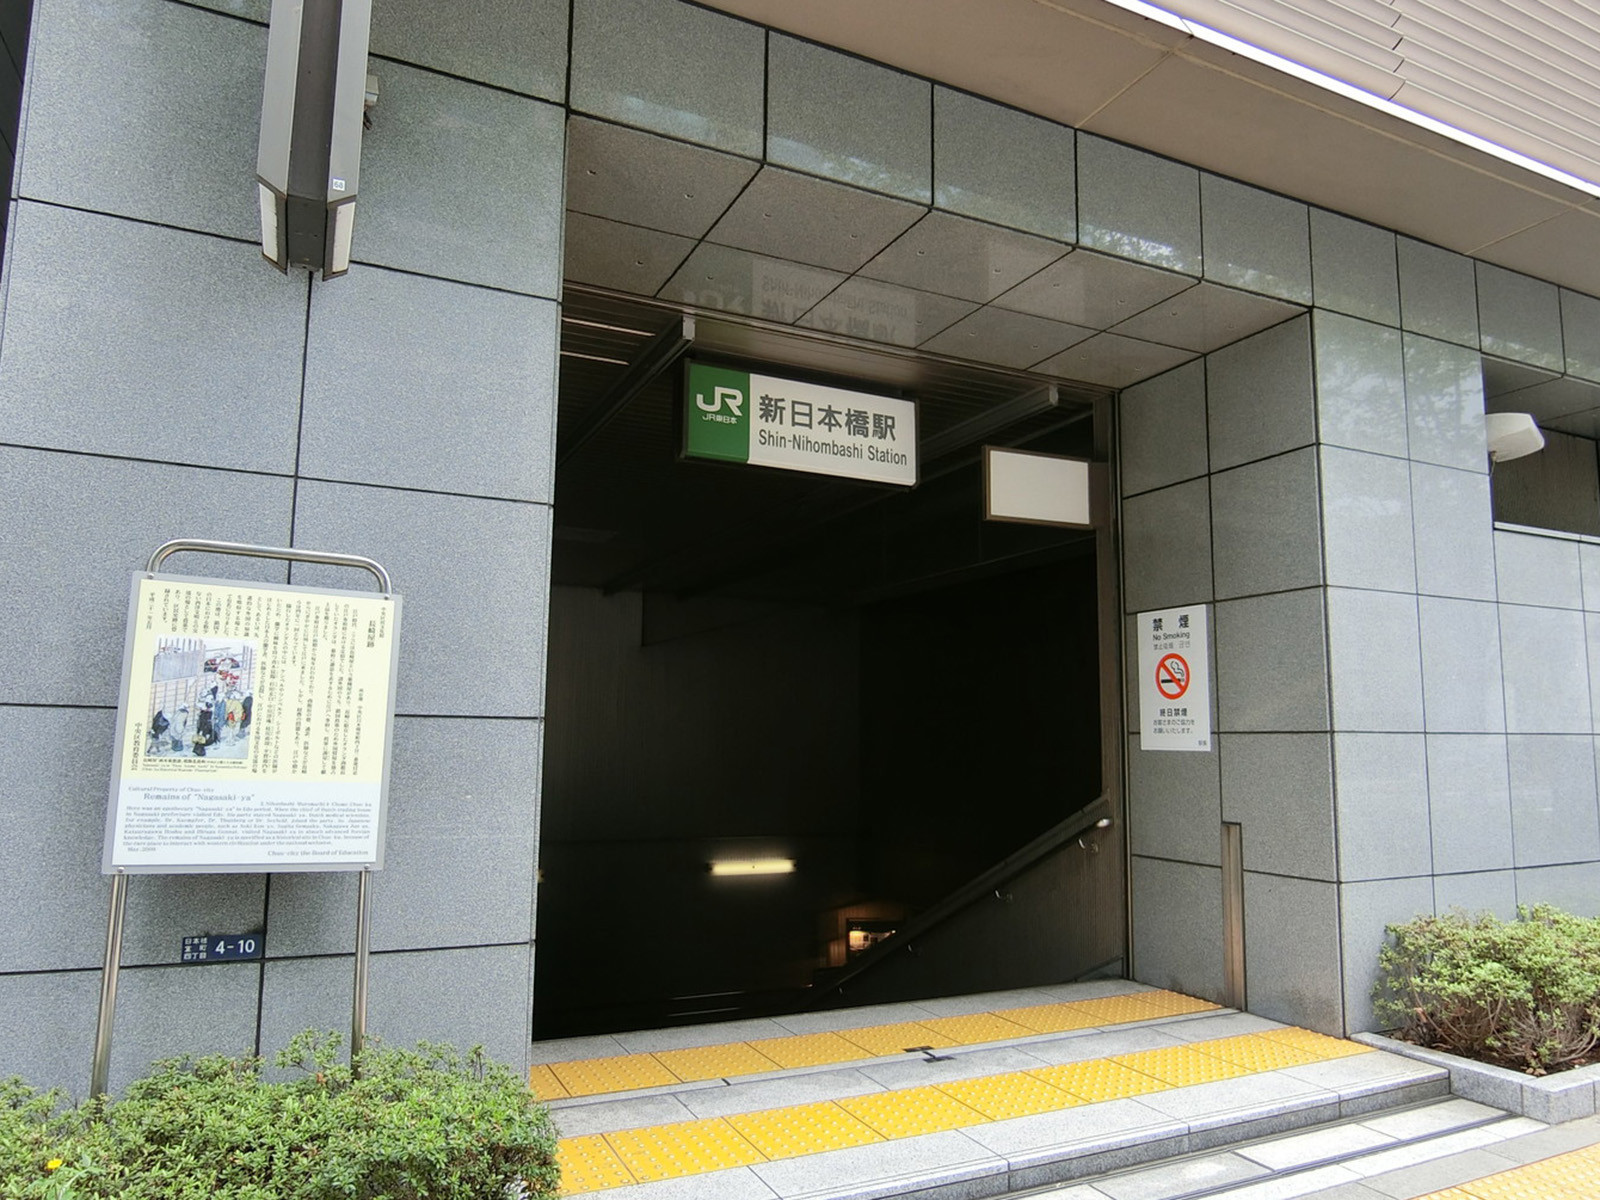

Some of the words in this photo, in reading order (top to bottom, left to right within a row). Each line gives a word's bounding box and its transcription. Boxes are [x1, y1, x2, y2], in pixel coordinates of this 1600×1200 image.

[696, 386, 743, 416] JR
[702, 413, 738, 424] JR東日本
[759, 394, 896, 442] 新日本橋駅
[758, 429, 863, 460] Shin-Nihombashi
[867, 444, 908, 466] Station
[1152, 633, 1162, 642] No
[1162, 631, 1190, 641] Smoking
[215, 939, 256, 955] 4-10
